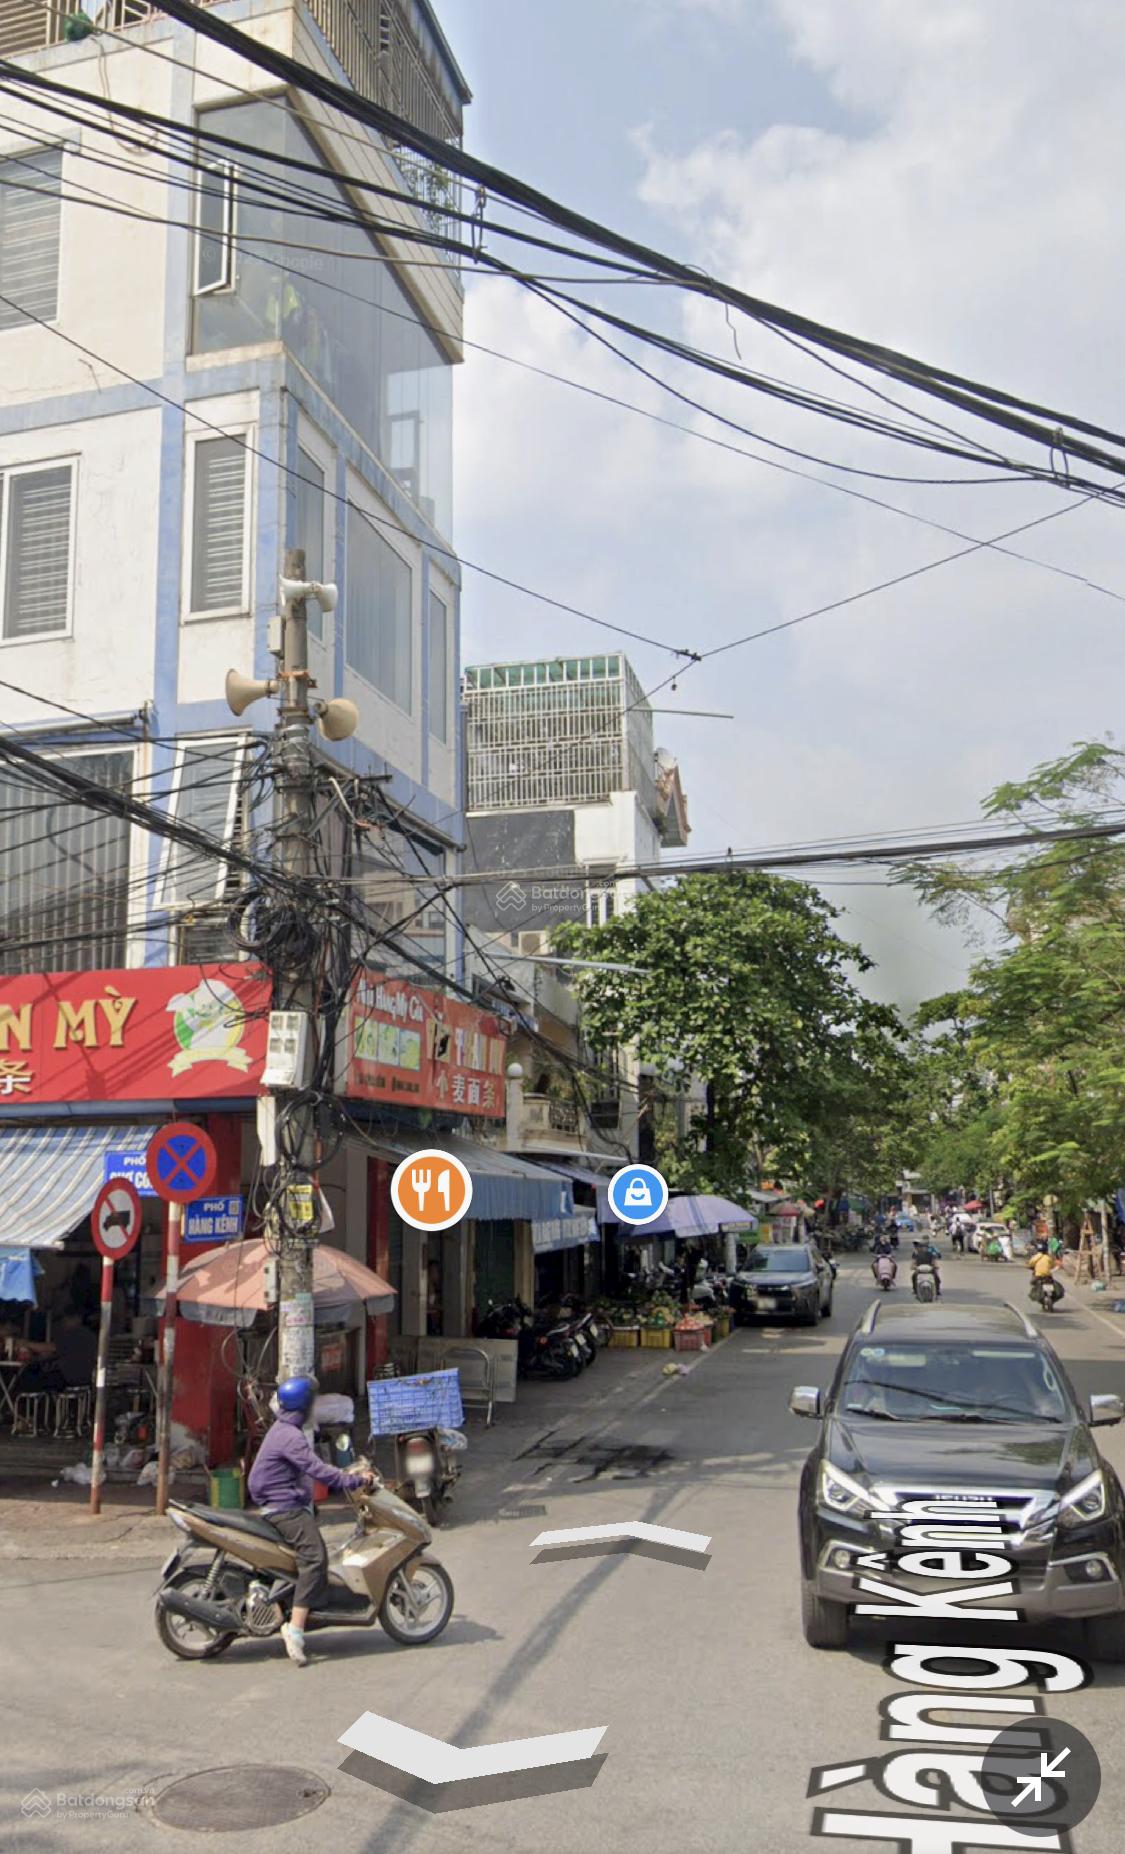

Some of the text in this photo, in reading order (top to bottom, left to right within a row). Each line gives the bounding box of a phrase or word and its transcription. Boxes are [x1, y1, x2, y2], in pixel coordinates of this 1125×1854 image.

[53, 985, 137, 1049] MỲ
[203, 1199, 225, 1212] PHỐ
[188, 1213, 213, 1235] HÀNG
